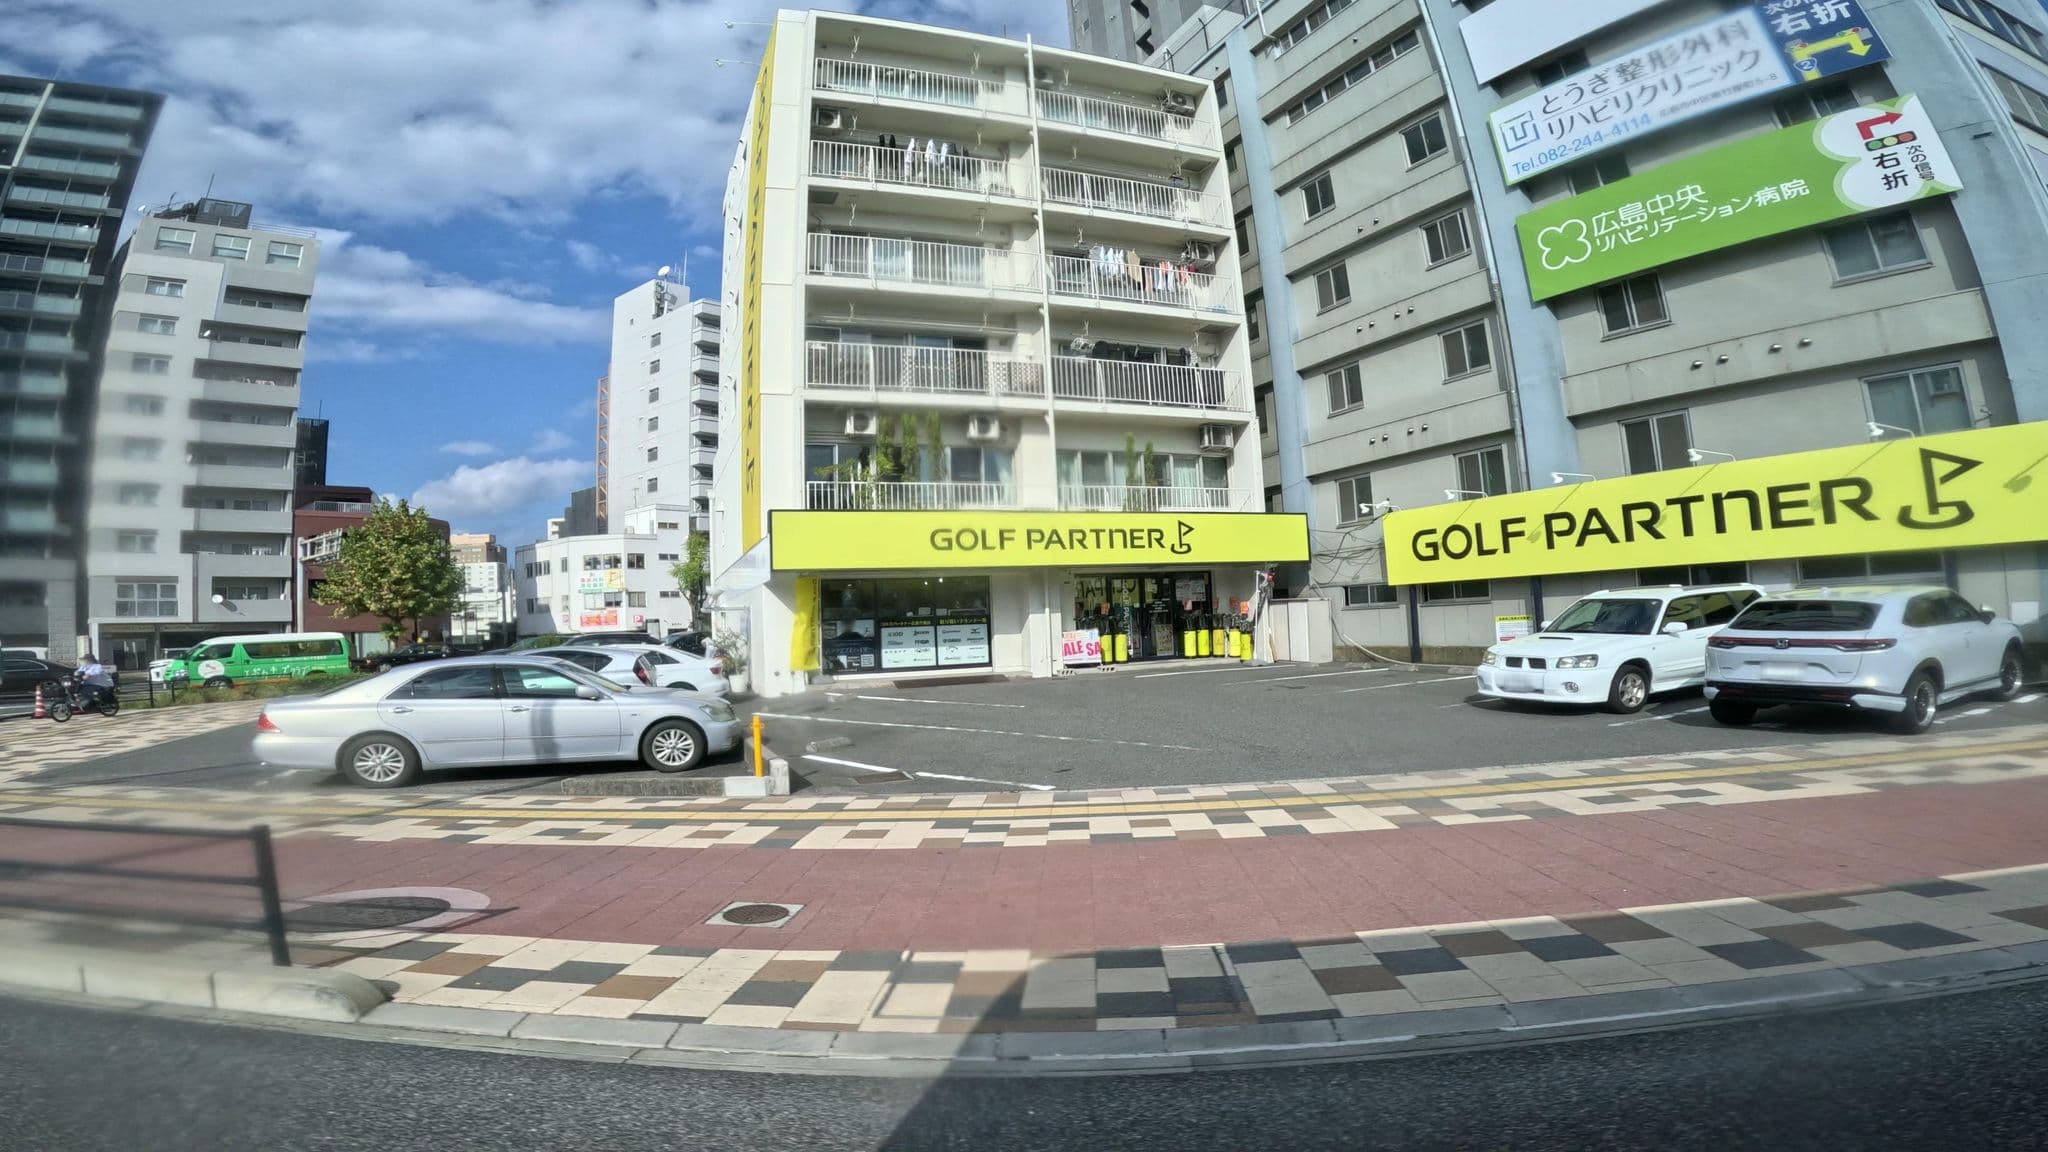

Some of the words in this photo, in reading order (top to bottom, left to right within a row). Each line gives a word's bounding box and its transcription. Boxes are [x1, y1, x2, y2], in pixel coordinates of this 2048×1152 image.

[1770, 0, 1852, 35] 右折
[1541, 19, 1750, 115] とうぎ整形外科
[1547, 47, 1761, 141] リハビリクリニック
[1872, 152, 1909, 191] 右折
[1905, 145, 1935, 181] 次の信号
[1592, 184, 1709, 237] 広島中央
[1597, 178, 1811, 252] リハビリテーション病院
[929, 527, 1016, 551] GOLF
[1025, 527, 1166, 551] PARTNER
[1411, 515, 1531, 562] GOLF
[1543, 476, 1881, 550] PARTNER
